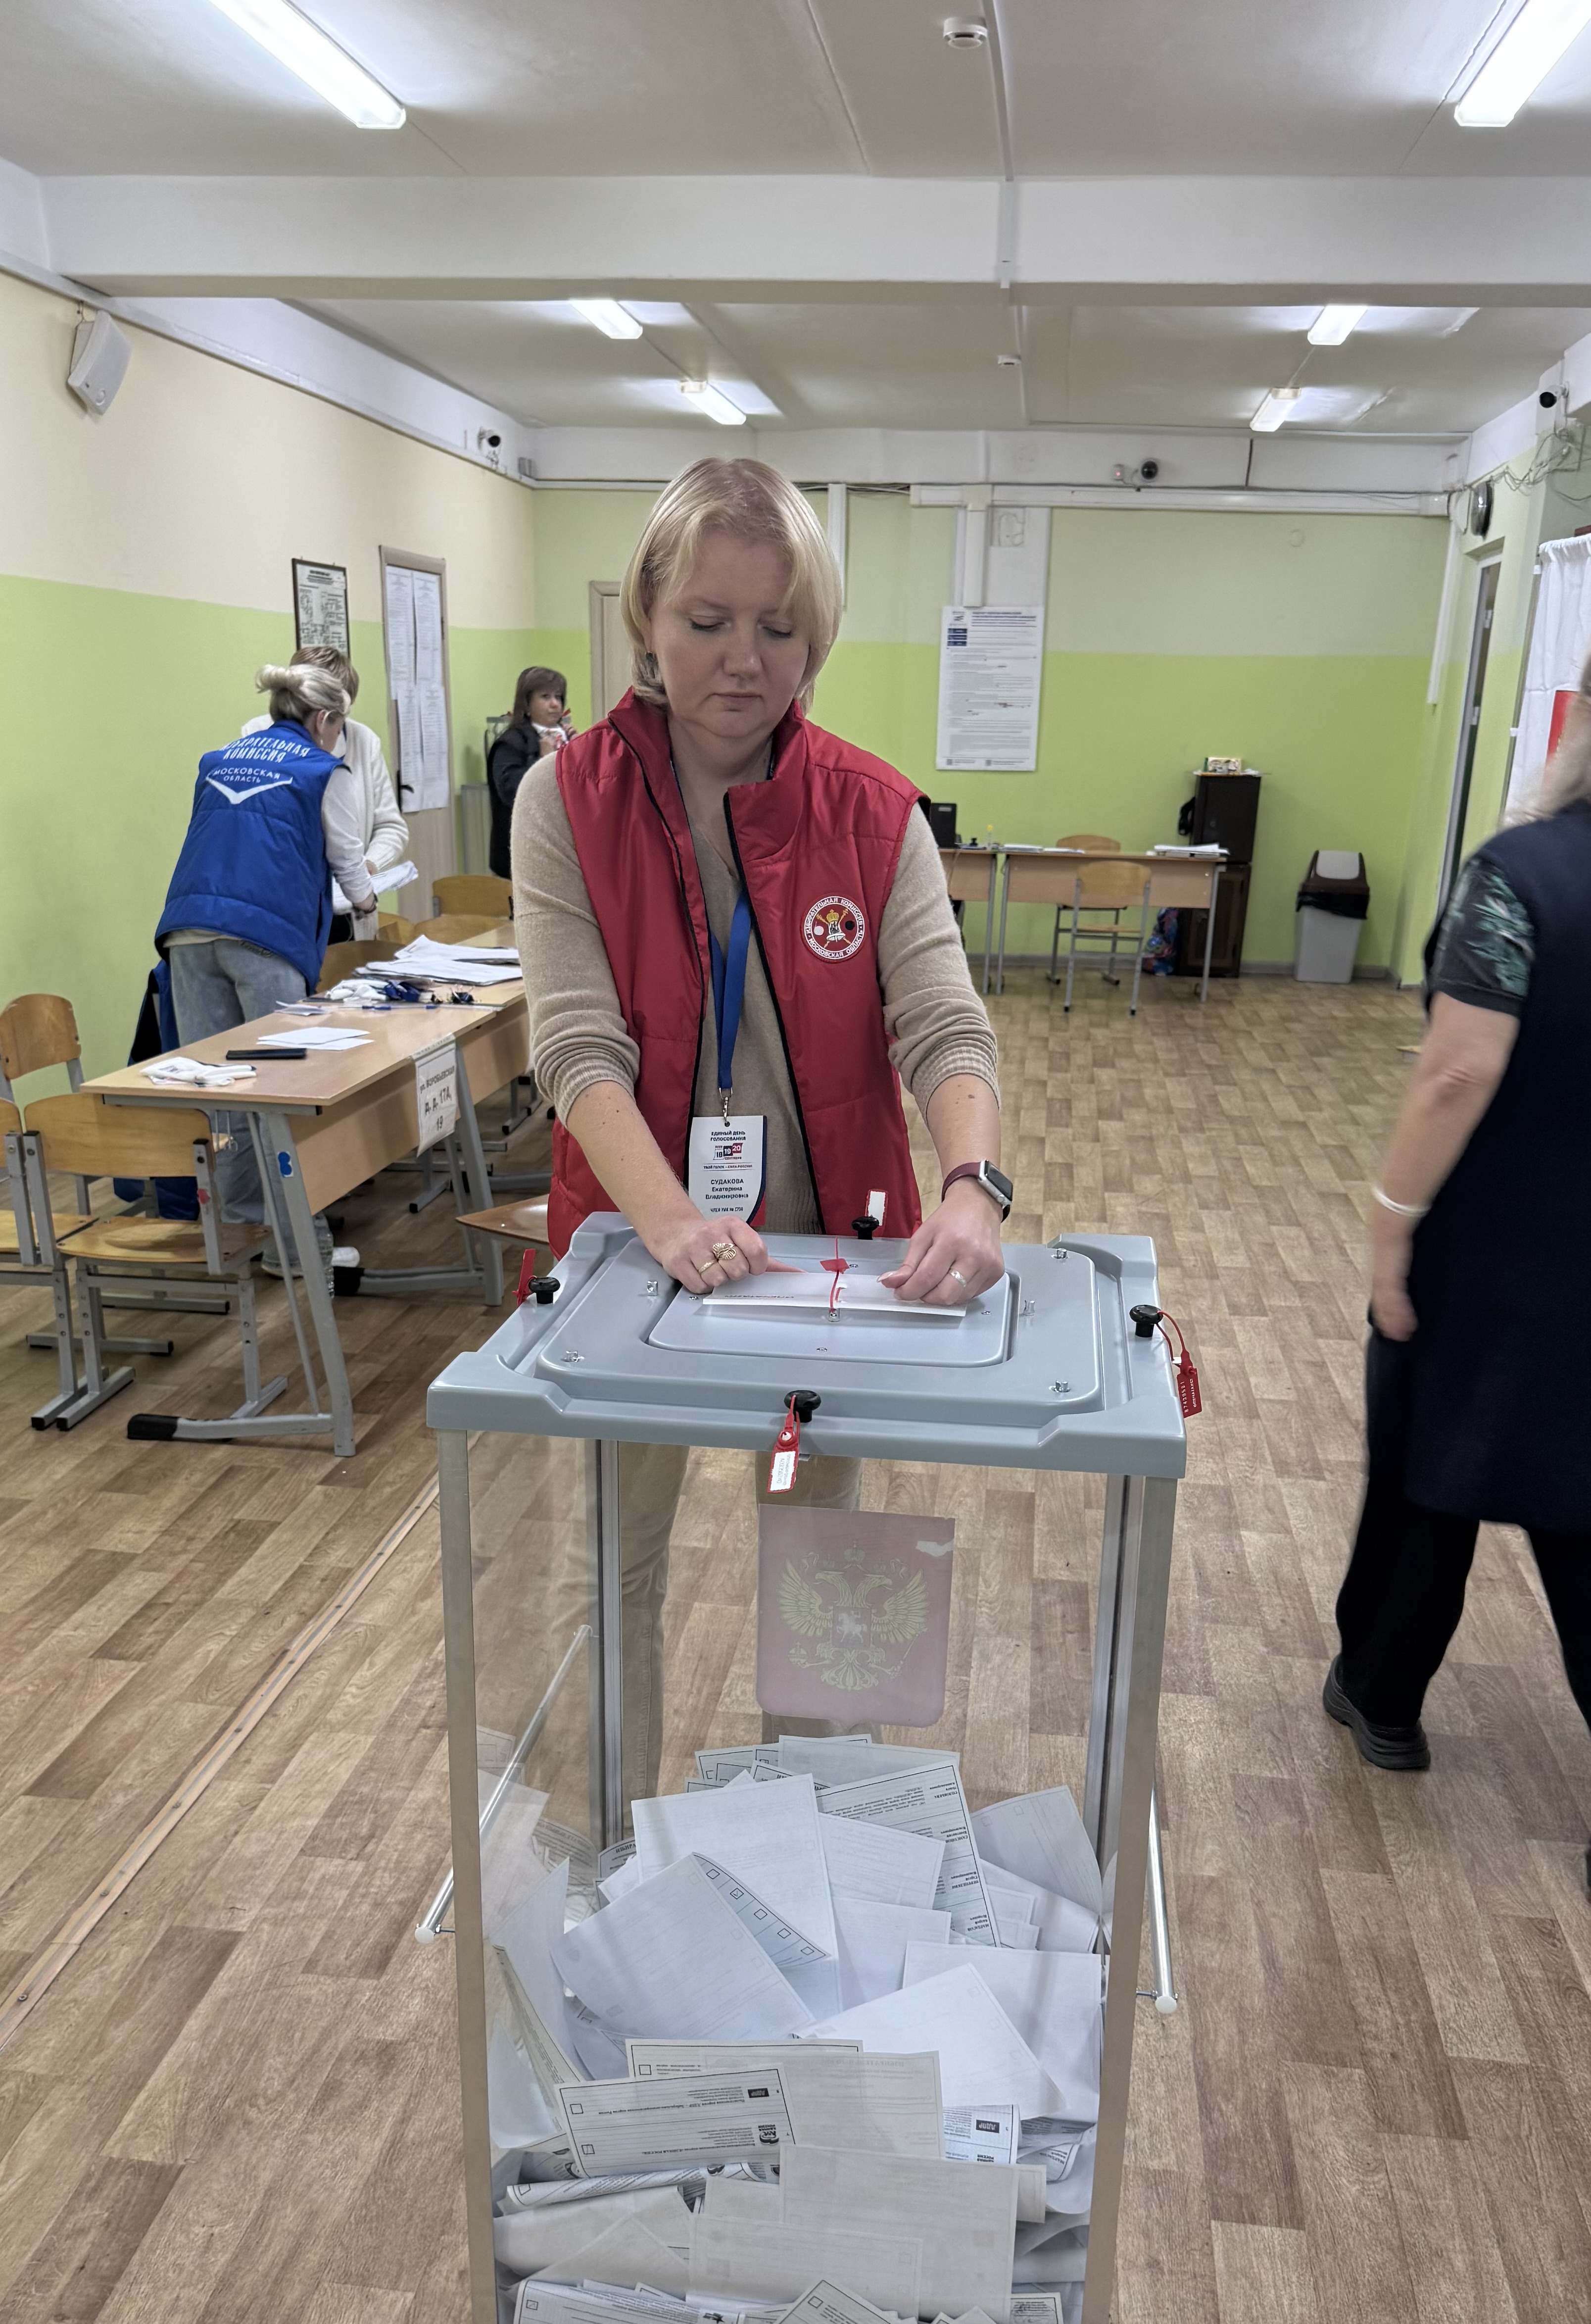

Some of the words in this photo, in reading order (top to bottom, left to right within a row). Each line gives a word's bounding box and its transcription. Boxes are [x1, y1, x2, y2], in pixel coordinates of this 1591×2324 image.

[223, 746, 287, 763] КОМИССИЯ
[212, 767, 280, 780] МОСКОВСКАЯ
[808, 938, 844, 957] МОСКОВСКАЯ
[436, 1115, 443, 1131] 19
